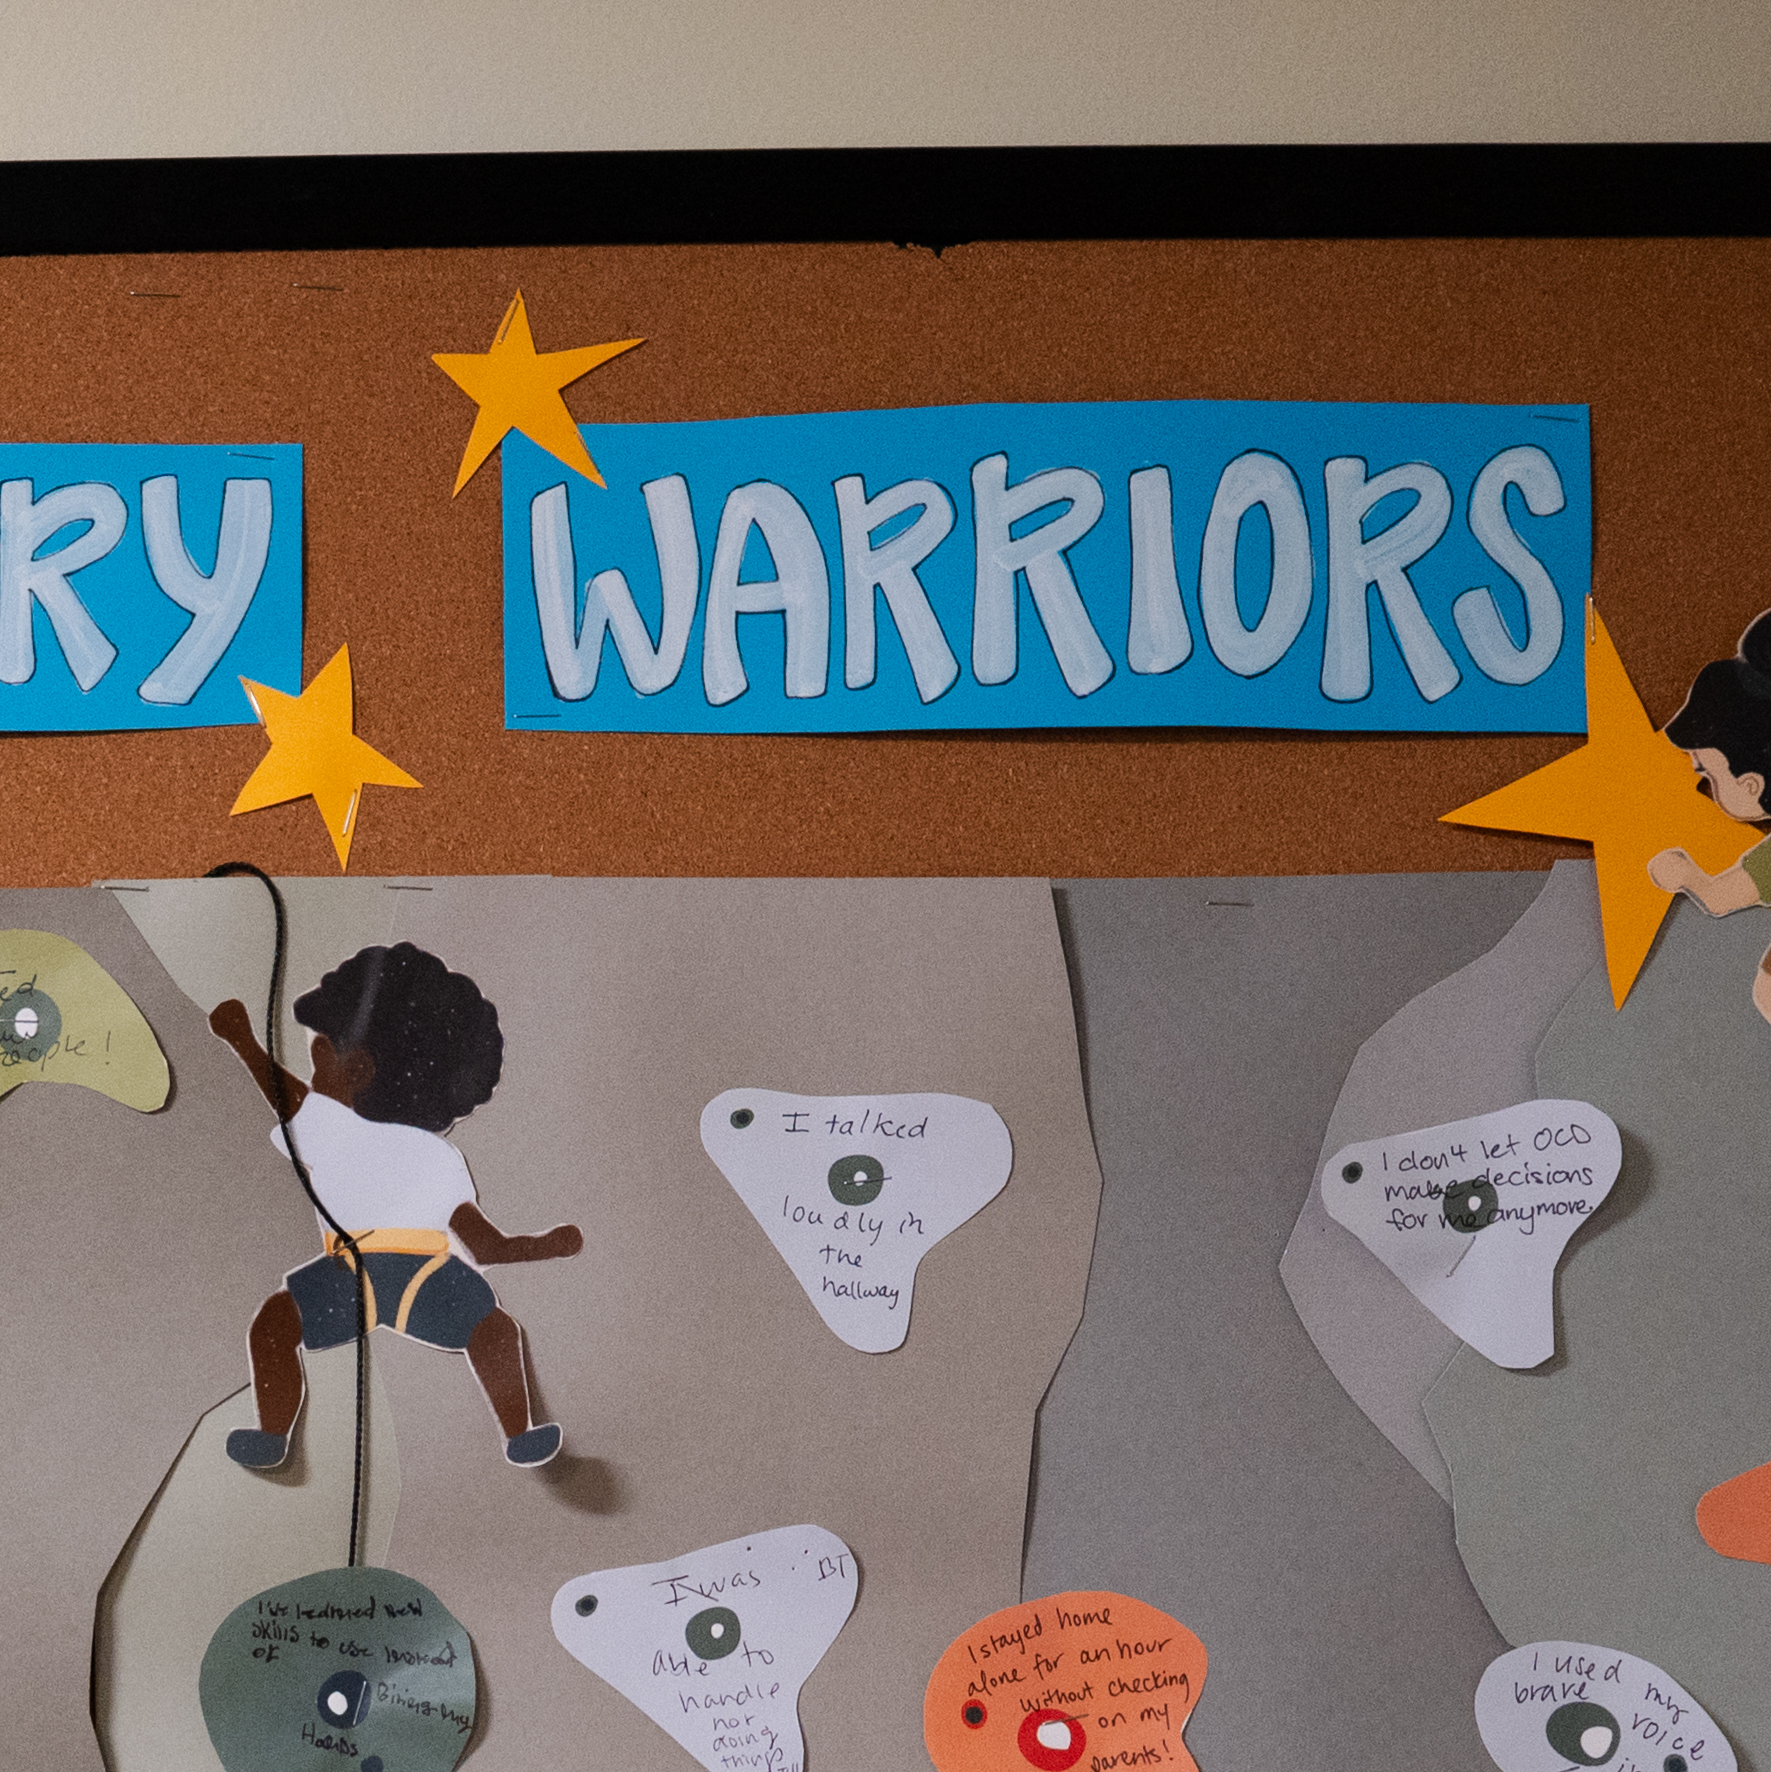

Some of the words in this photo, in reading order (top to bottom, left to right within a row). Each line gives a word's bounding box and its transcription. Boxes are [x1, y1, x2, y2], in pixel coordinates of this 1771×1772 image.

[530, 444, 1567, 707] WARRIORS
[781, 1111, 811, 1134] I
[825, 1108, 929, 1140] talked
[1479, 1133, 1521, 1160] let
[1532, 1123, 1592, 1152] OCD
[1383, 1180, 1458, 1202] make
[1472, 1161, 1594, 1189] decisions
[782, 1194, 884, 1247] loudly
[899, 1211, 925, 1236] in
[1385, 1208, 1427, 1232] for
[1488, 1198, 1594, 1236] anymore.
[818, 1243, 863, 1269] the
[822, 1275, 900, 1311] hallway
[979, 1613, 1043, 1662] stayed
[1056, 1606, 1114, 1631] home
[651, 1649, 710, 1678] able
[967, 1669, 1027, 1698] alone
[1033, 1651, 1066, 1680] for
[1115, 1637, 1173, 1660] hour
[679, 1682, 780, 1714] handle
[1107, 1669, 1191, 1704] checking
[1554, 1655, 1622, 1683] used
[1644, 1682, 1690, 1725] my
[1097, 1711, 1127, 1730] on
[1139, 1702, 1170, 1731] my
[1513, 1681, 1590, 1705] brave
[1631, 1712, 1706, 1761] voice
